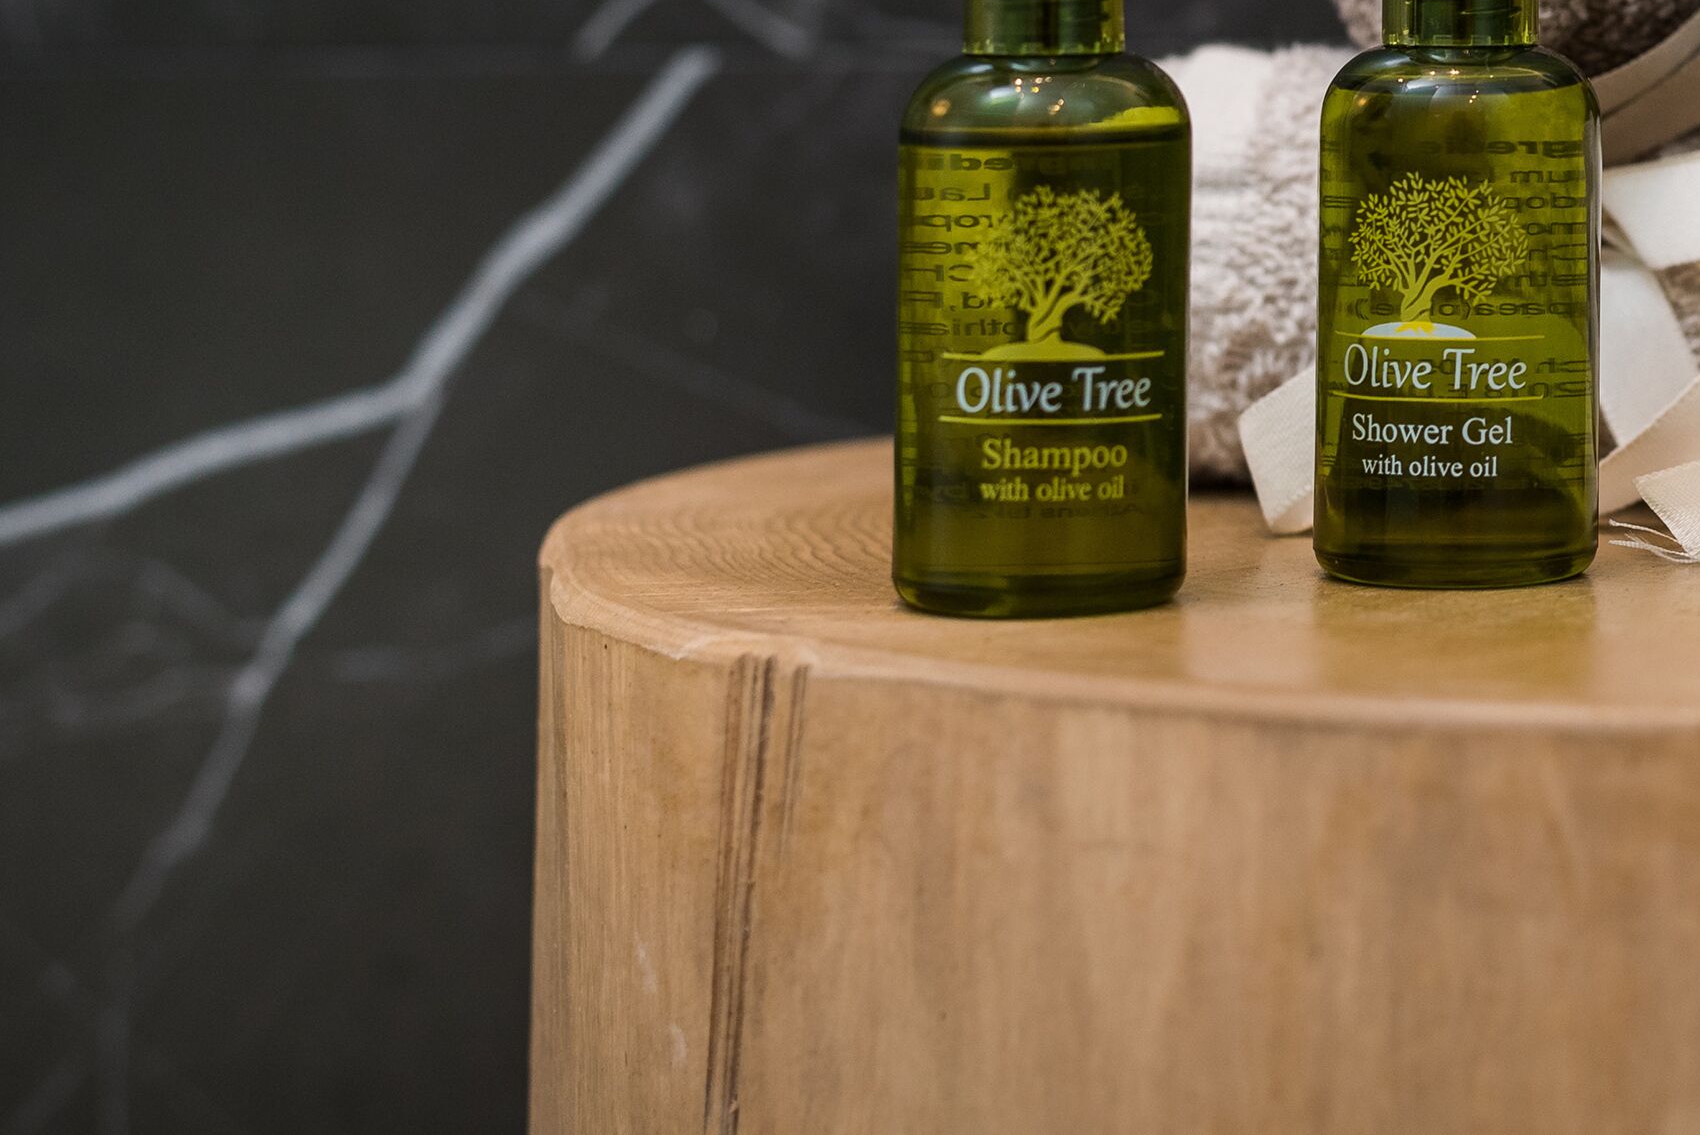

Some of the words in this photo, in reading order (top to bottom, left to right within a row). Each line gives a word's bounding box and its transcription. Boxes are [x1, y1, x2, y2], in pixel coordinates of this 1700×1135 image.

[1344, 343, 1432, 390] Olive
[1442, 348, 1527, 390] Tree
[956, 366, 1062, 413] Olive
[1072, 367, 1151, 411] Tree
[1351, 412, 1453, 445] Shower
[1461, 416, 1513, 446] Gel
[982, 438, 1128, 477] Shampoo
[1361, 455, 1403, 476] with
[1408, 456, 1464, 477] olive
[1469, 456, 1498, 478] oil
[981, 478, 1029, 502] with
[1035, 477, 1092, 502] olive
[1098, 475, 1125, 500] oil
